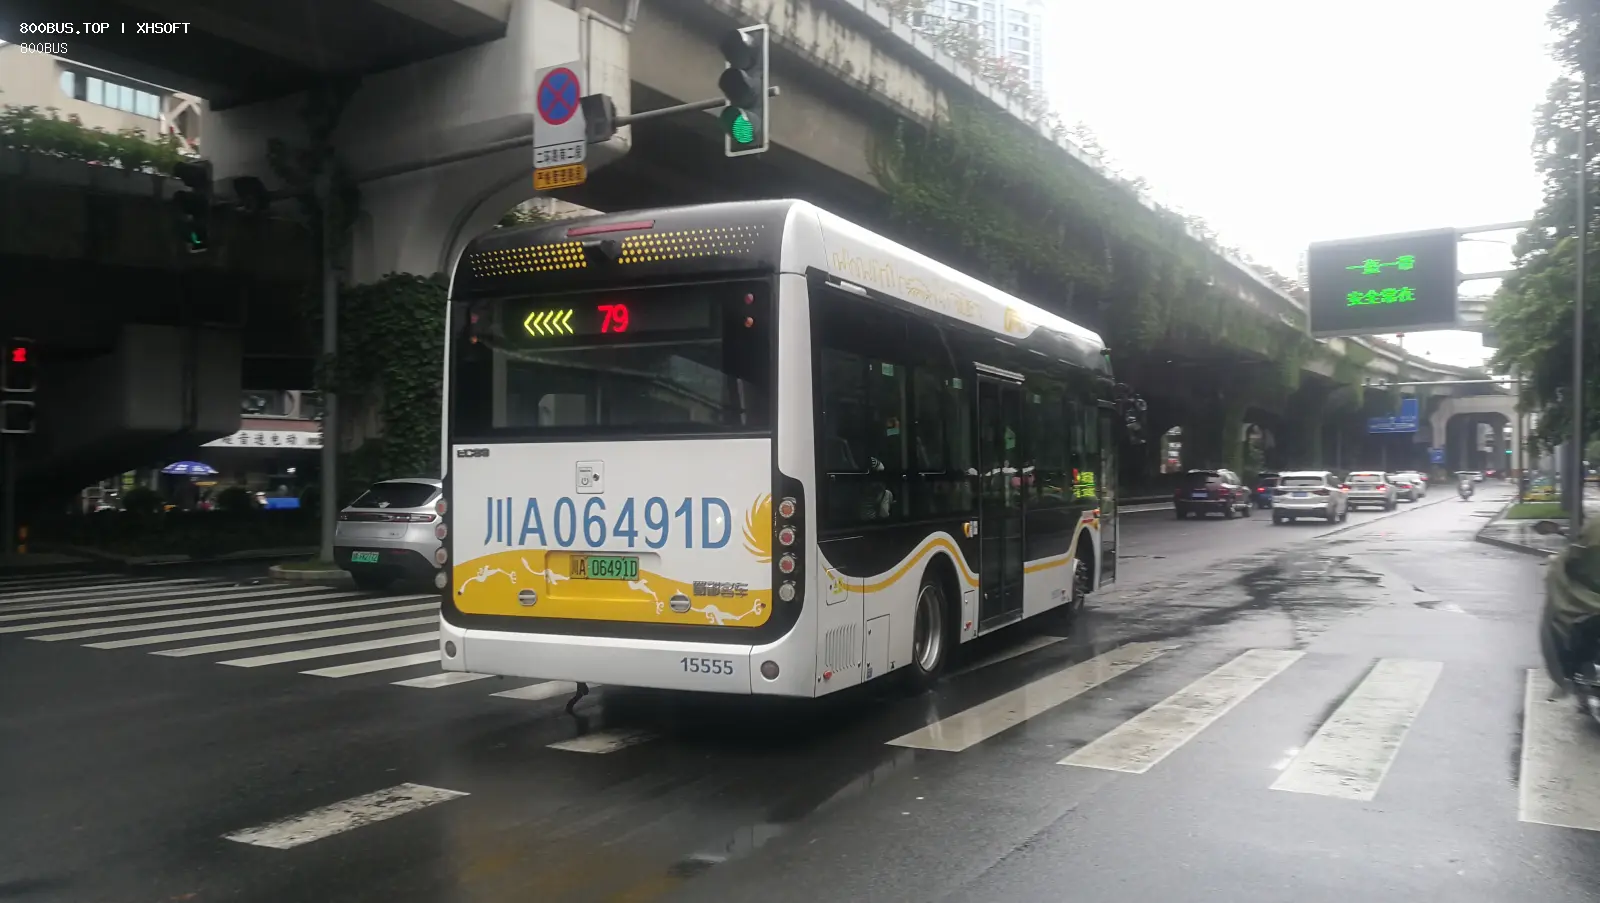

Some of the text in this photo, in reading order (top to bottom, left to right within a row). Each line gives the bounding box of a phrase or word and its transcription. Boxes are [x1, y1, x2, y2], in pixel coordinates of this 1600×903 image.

[597, 303, 630, 334] 79
[484, 496, 732, 550] 川A06491D
[680, 657, 734, 675] 15555
